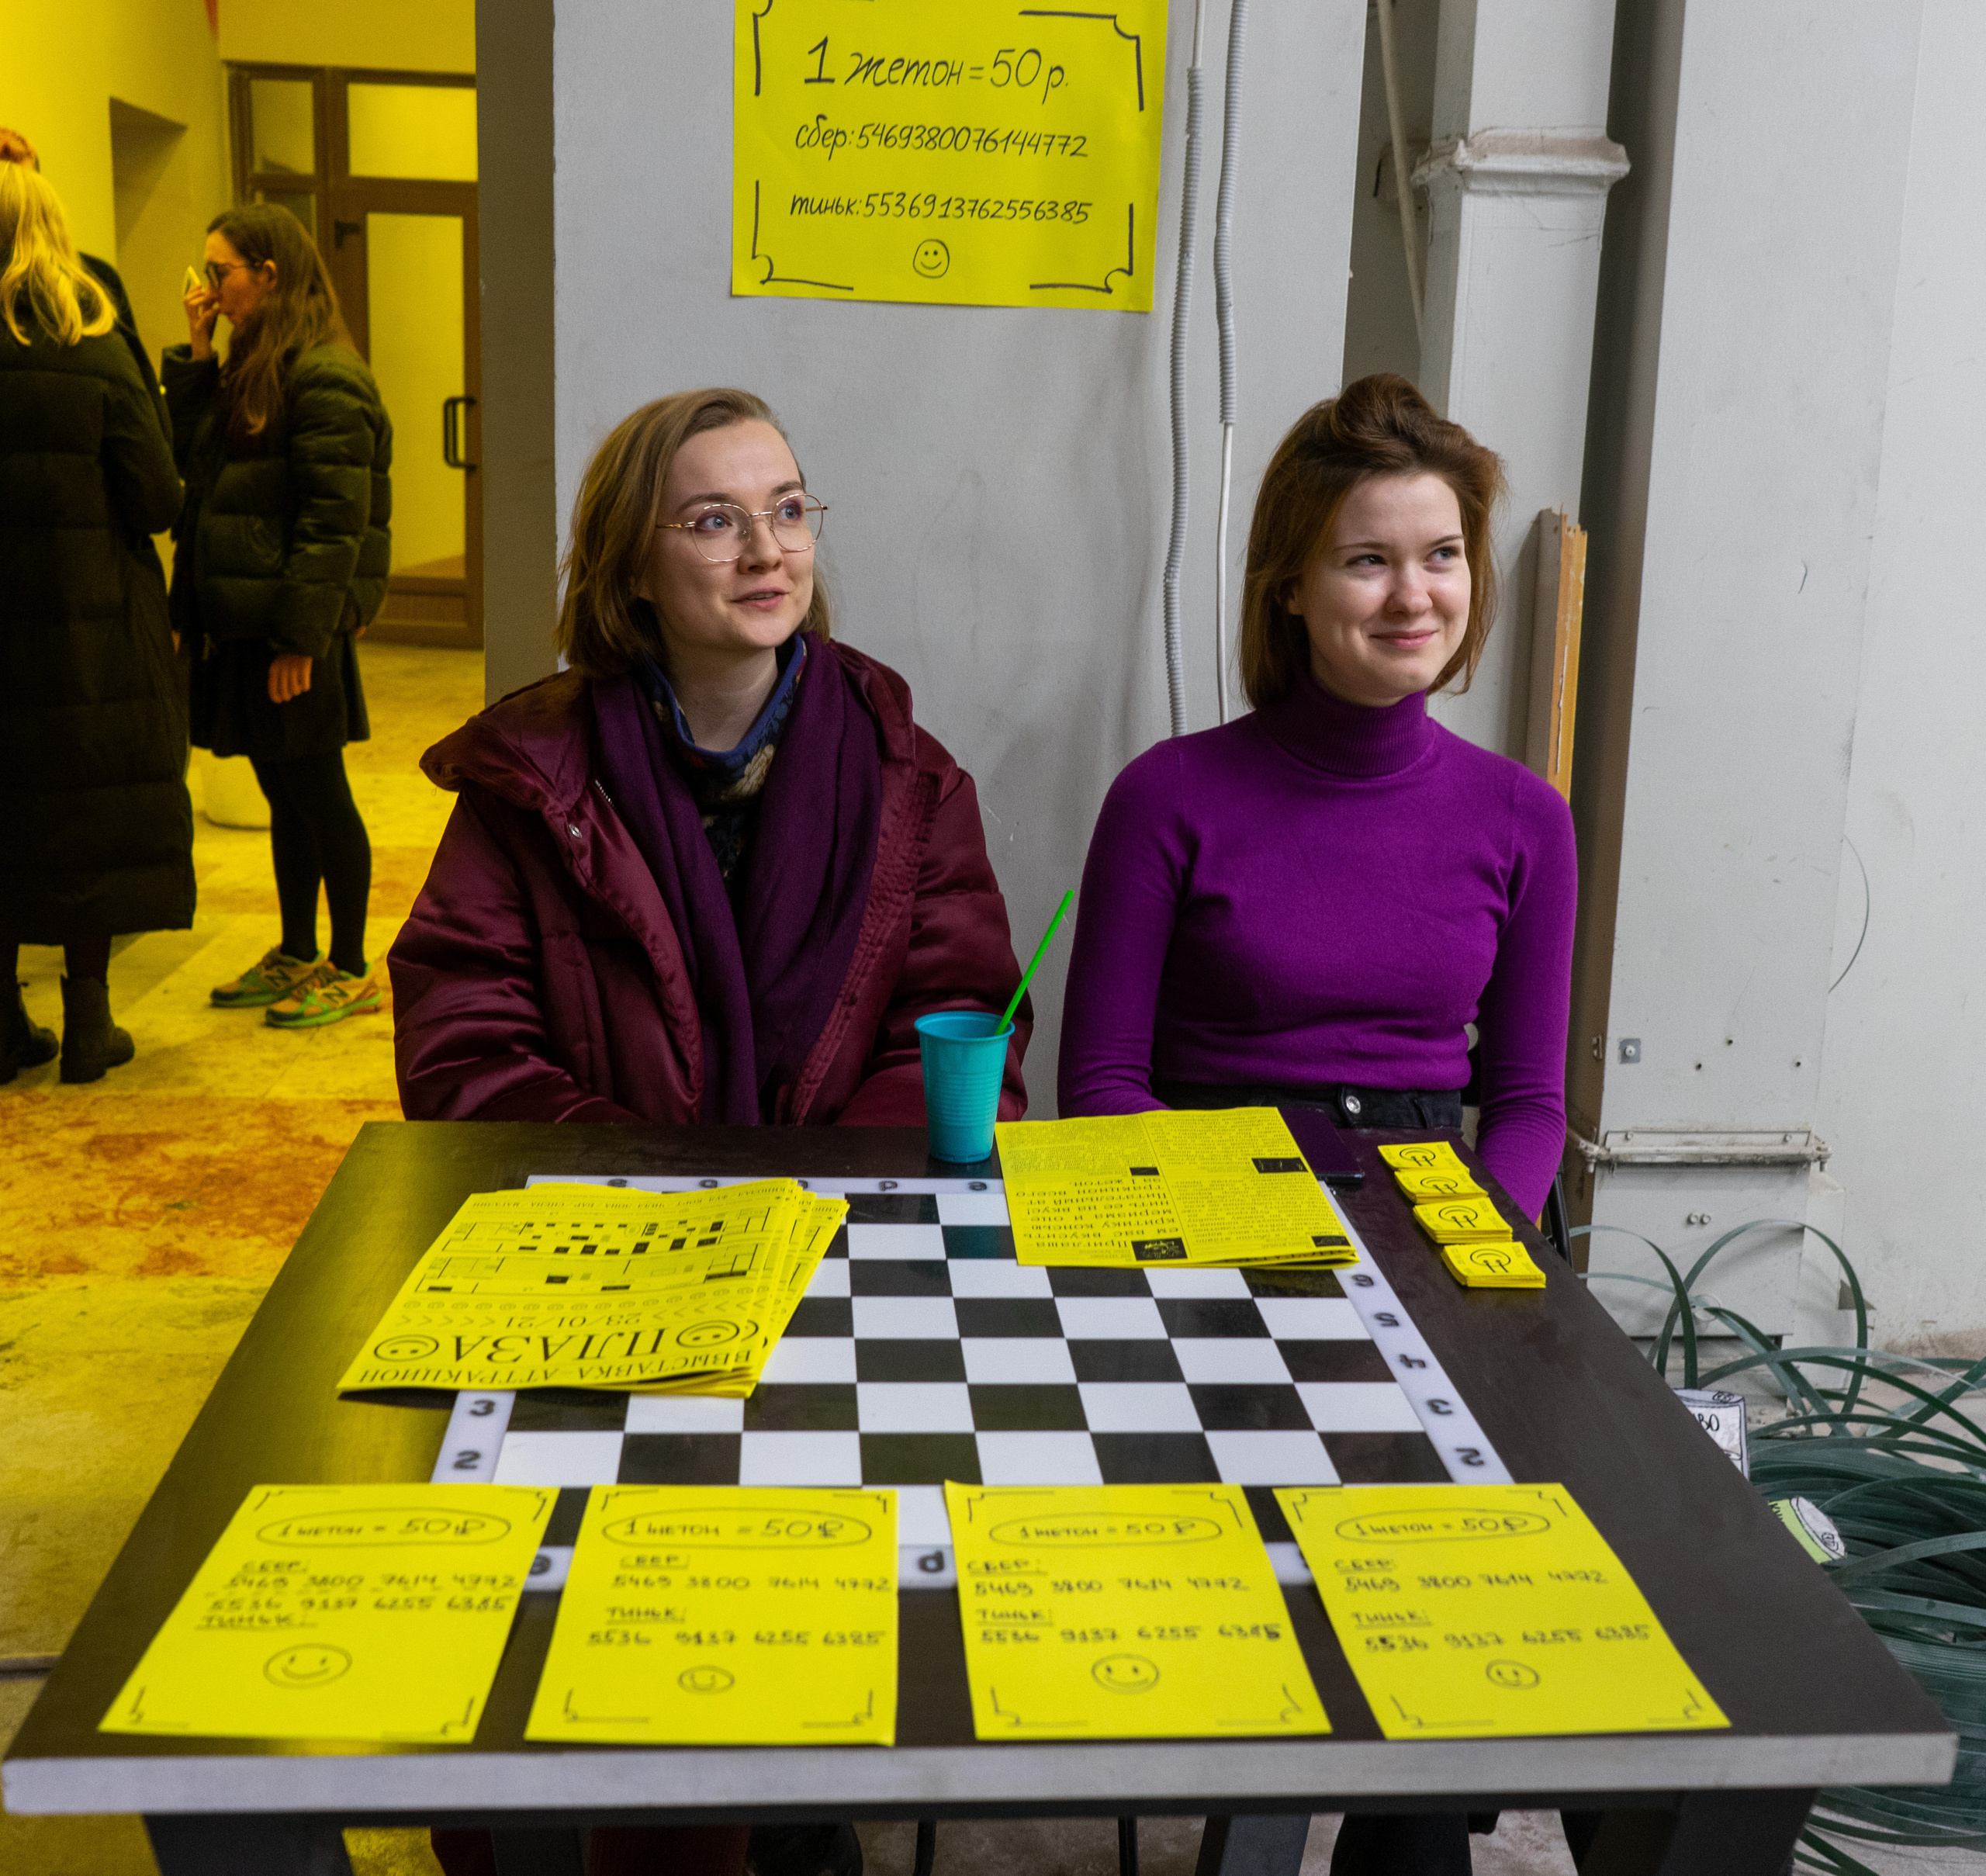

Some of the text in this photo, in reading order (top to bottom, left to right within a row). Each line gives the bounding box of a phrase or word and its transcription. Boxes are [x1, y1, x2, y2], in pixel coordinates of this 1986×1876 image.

[804, 36, 835, 84] 1
[452, 1327, 669, 1364] ПЛАЗА
[918, 1549, 945, 1573] d
